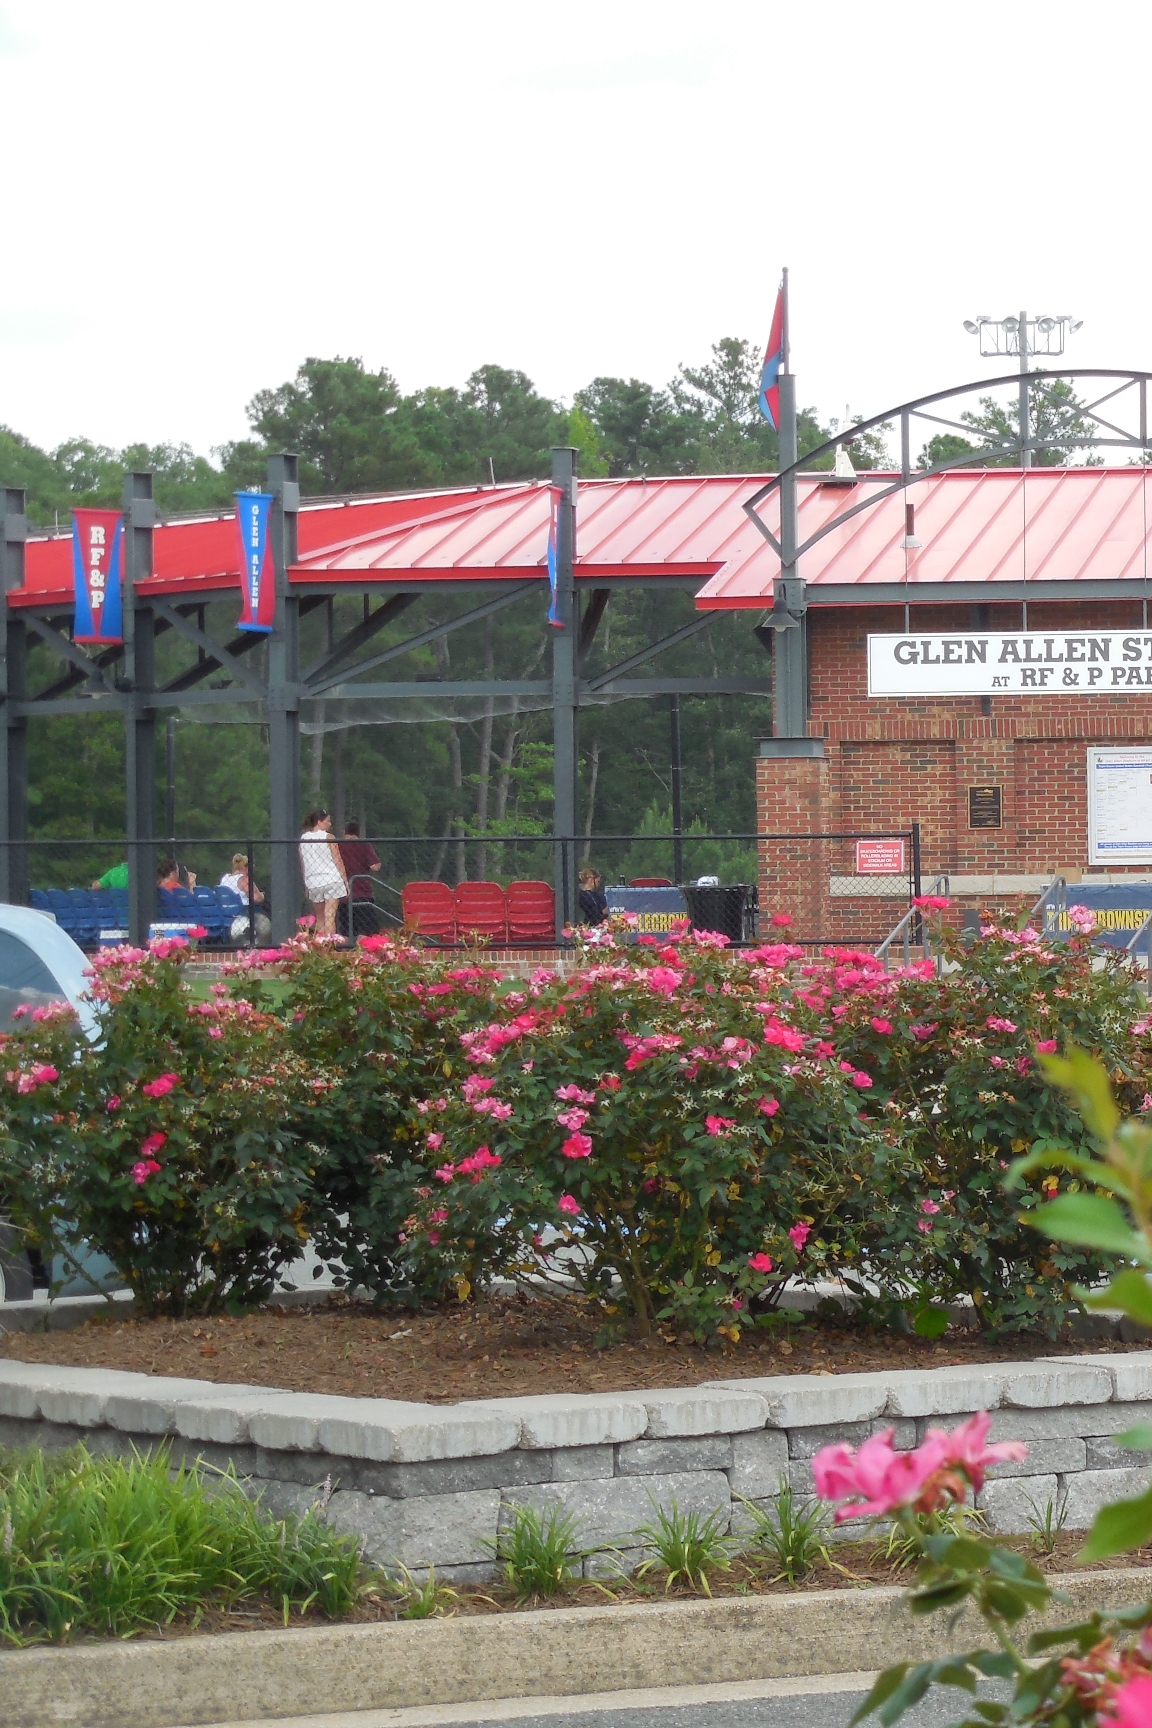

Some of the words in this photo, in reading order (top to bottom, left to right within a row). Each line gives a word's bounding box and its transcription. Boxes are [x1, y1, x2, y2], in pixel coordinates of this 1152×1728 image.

[251, 505, 259, 547] GLEN
[90, 526, 105, 609] RF&P
[251, 554, 259, 608] ALLEN
[894, 640, 988, 665] GLEN
[998, 638, 1112, 663] ALLEN
[992, 676, 1010, 687] AT
[1020, 667, 1054, 686] RF
[1062, 667, 1079, 686] &
[1087, 667, 1103, 685] P
